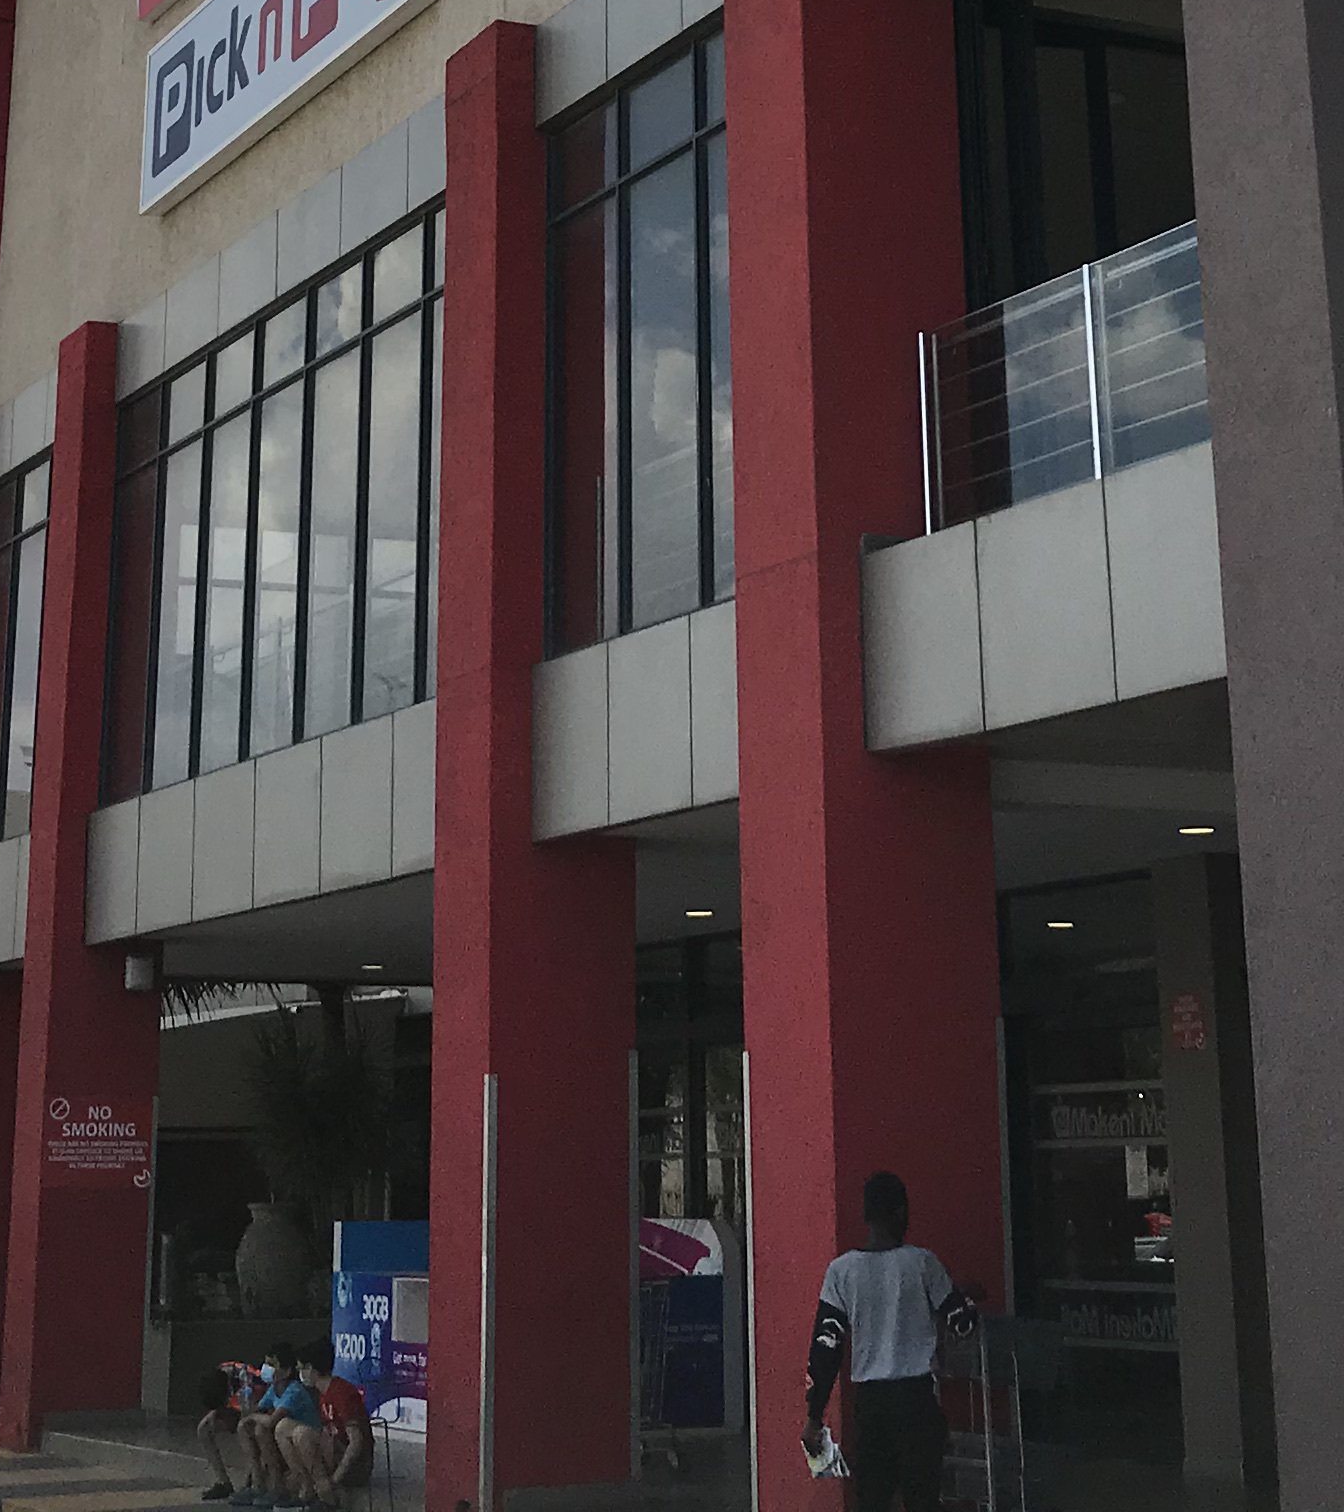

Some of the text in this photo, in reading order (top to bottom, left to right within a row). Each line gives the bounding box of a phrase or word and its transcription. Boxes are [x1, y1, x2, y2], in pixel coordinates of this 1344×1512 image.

[152, 4, 253, 178] Pick
[88, 1106, 112, 1120] NO
[1141, 1106, 1167, 1137] Ma
[62, 1122, 136, 1137] SMOKING
[363, 1293, 389, 1322] 30GB
[335, 1333, 366, 1361] K200
